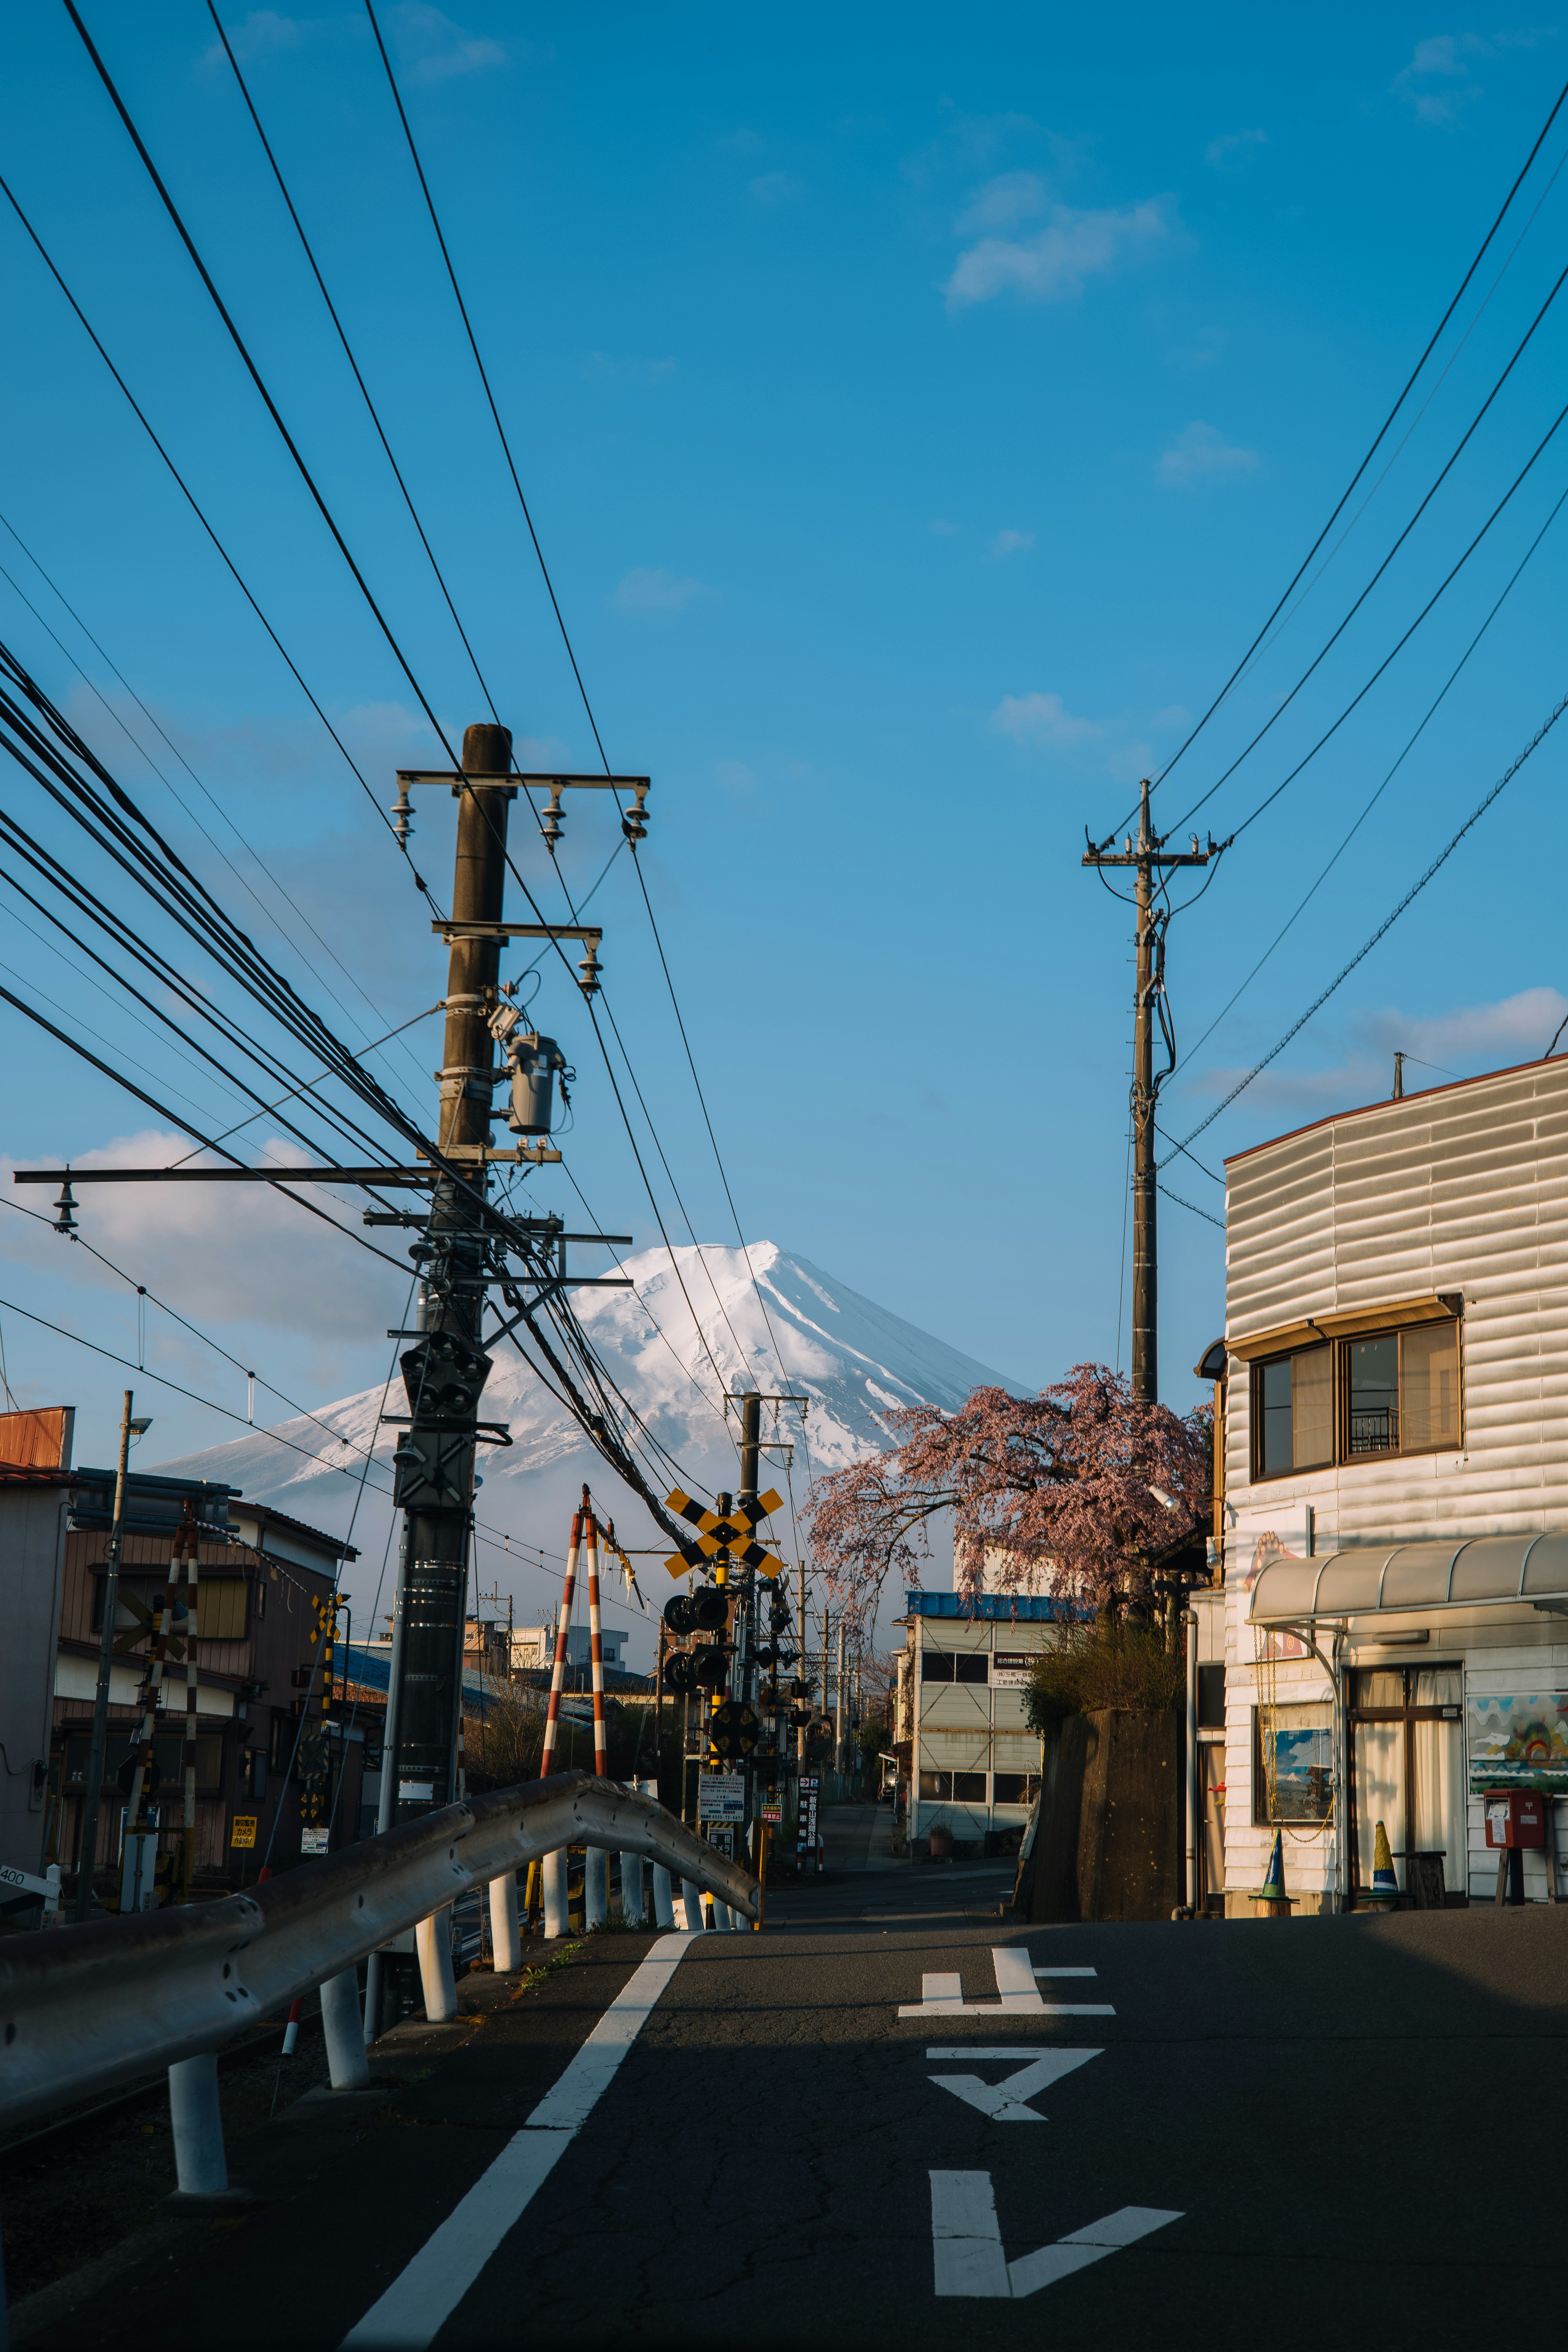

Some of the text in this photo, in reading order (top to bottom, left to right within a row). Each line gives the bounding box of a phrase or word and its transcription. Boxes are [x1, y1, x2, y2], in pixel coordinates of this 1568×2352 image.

[799, 1801, 808, 1837] 駐車場
[808, 1796, 817, 1847] 新倉山浅間公園
